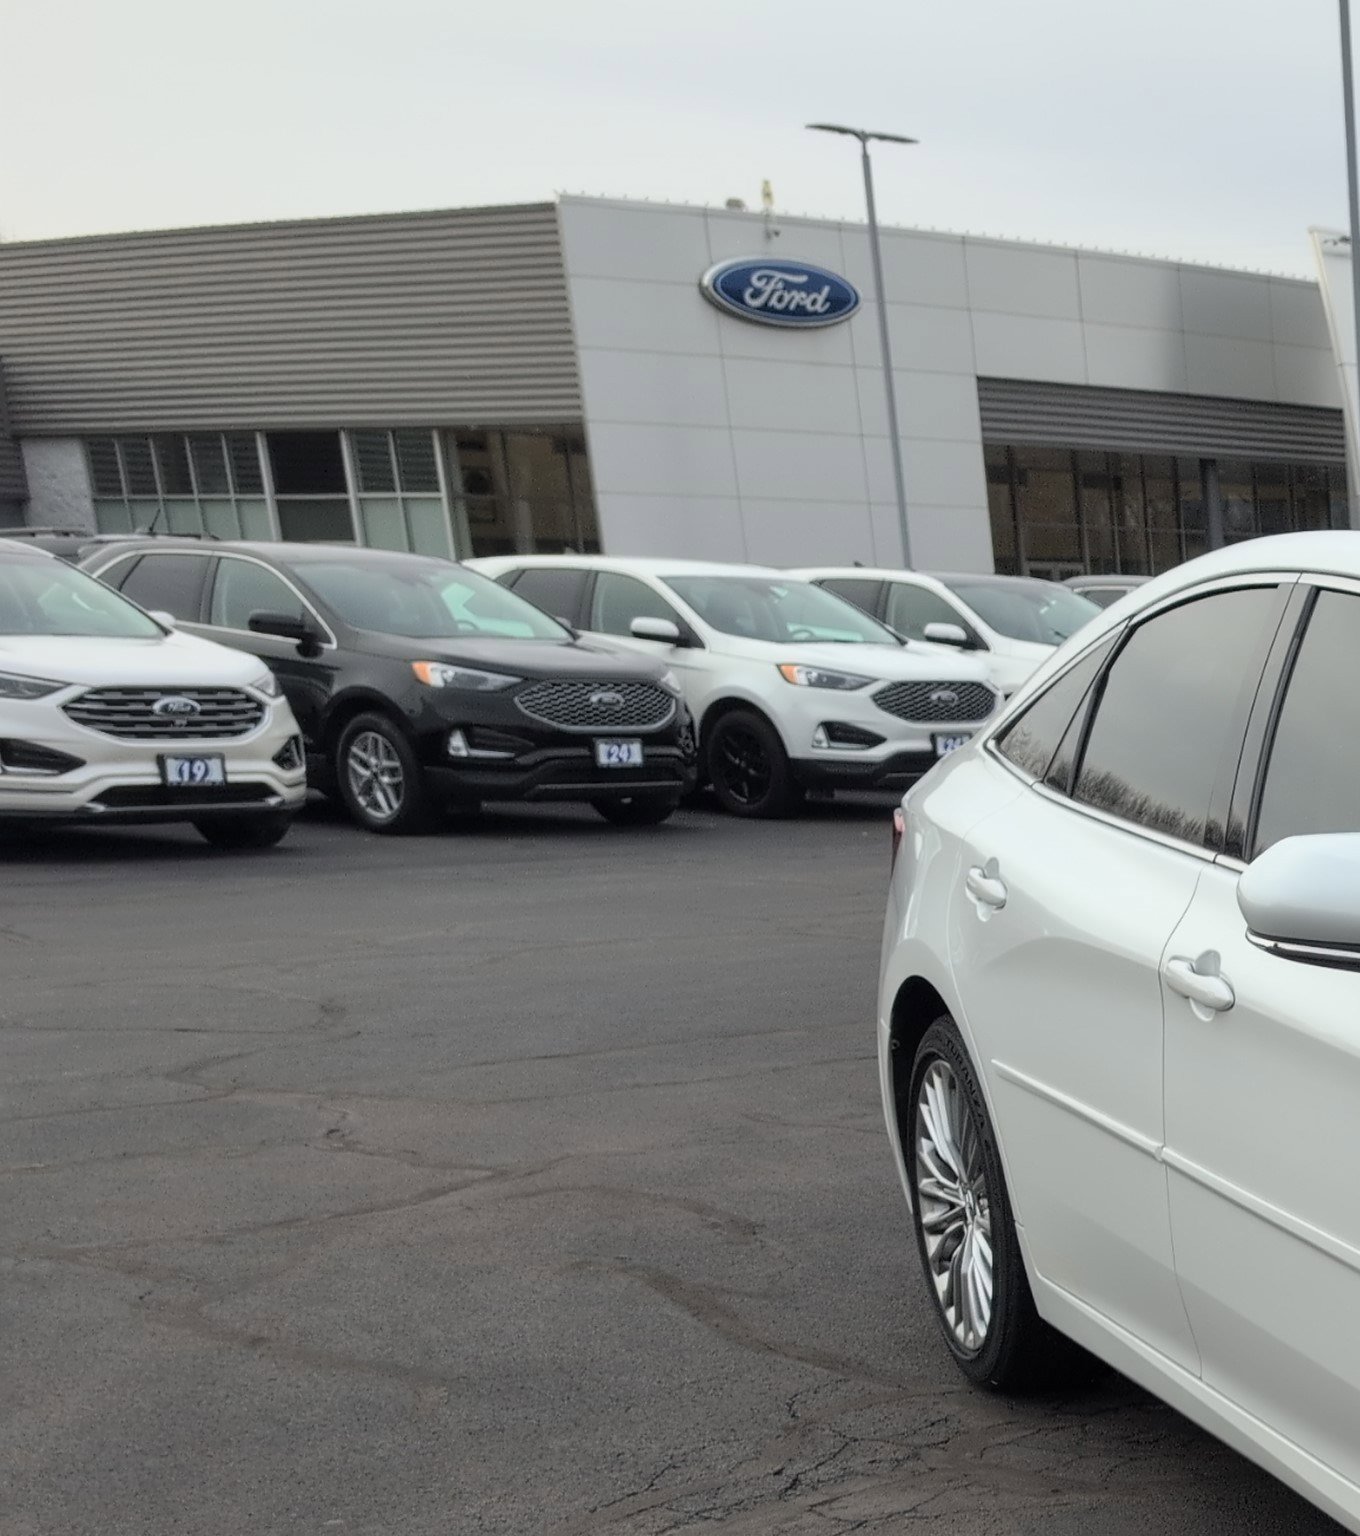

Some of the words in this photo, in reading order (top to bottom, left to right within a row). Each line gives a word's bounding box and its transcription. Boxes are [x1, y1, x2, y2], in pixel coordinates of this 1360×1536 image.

[744, 269, 831, 313] Ford
[609, 743, 629, 762] 24
[181, 760, 206, 782] 19
